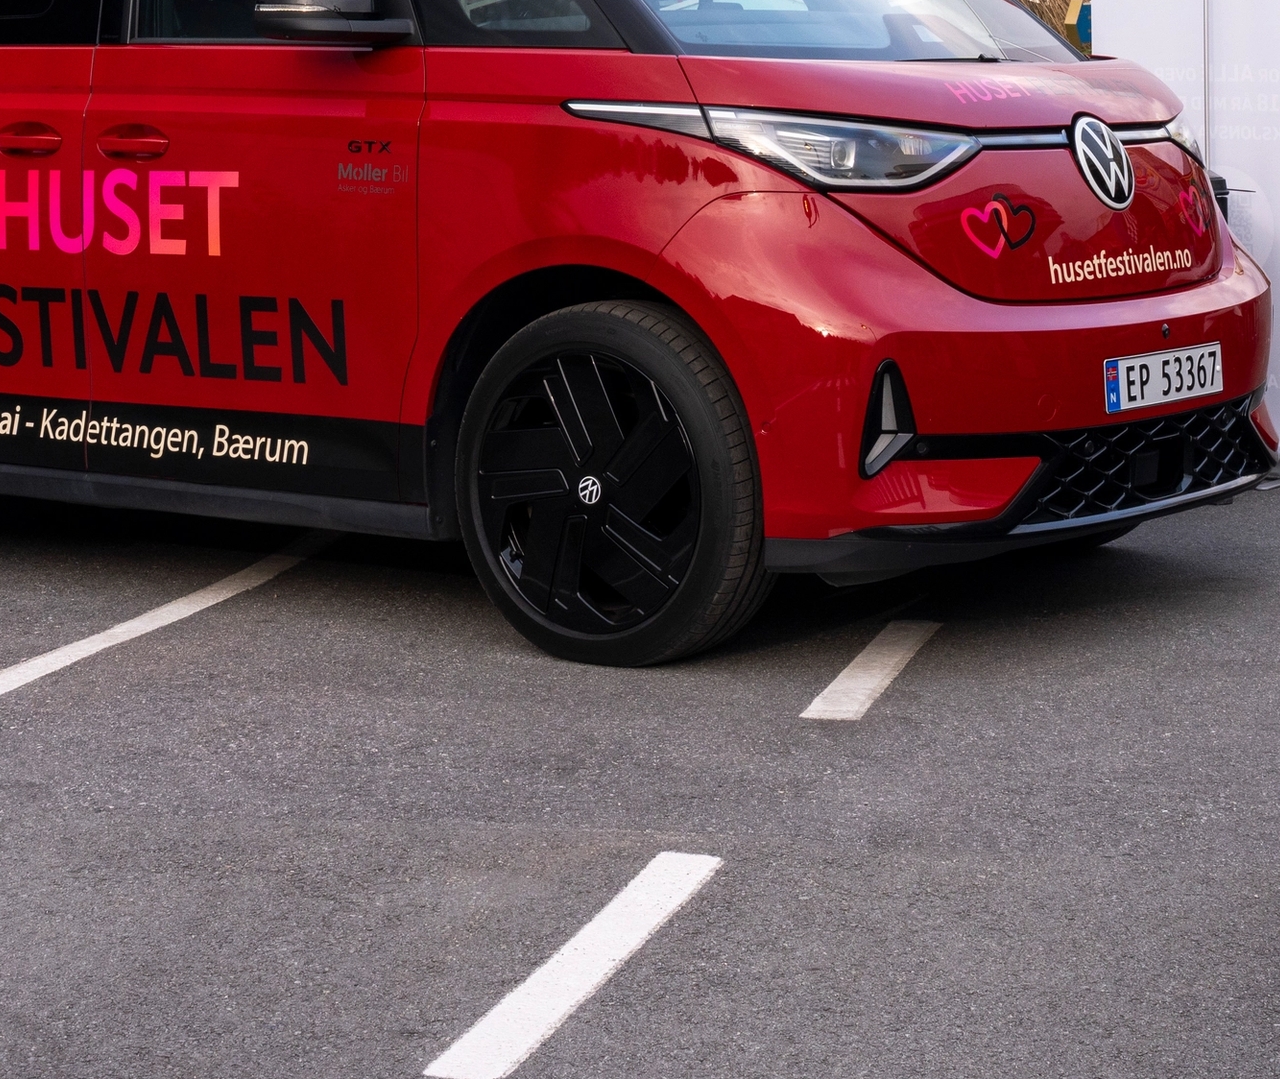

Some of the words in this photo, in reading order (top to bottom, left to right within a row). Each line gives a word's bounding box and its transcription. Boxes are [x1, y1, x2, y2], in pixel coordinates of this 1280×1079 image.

[944, 77, 1032, 104] HUSET
[348, 139, 391, 154] GTX
[392, 164, 409, 183] Bil
[1048, 244, 1192, 284] husetfestivalen.no
[1125, 363, 1150, 402] EP
[1161, 350, 1217, 396] 53367
[1110, 392, 1117, 404] N
[39, 407, 205, 459] Kadettangen,
[212, 424, 310, 465] Bærum
